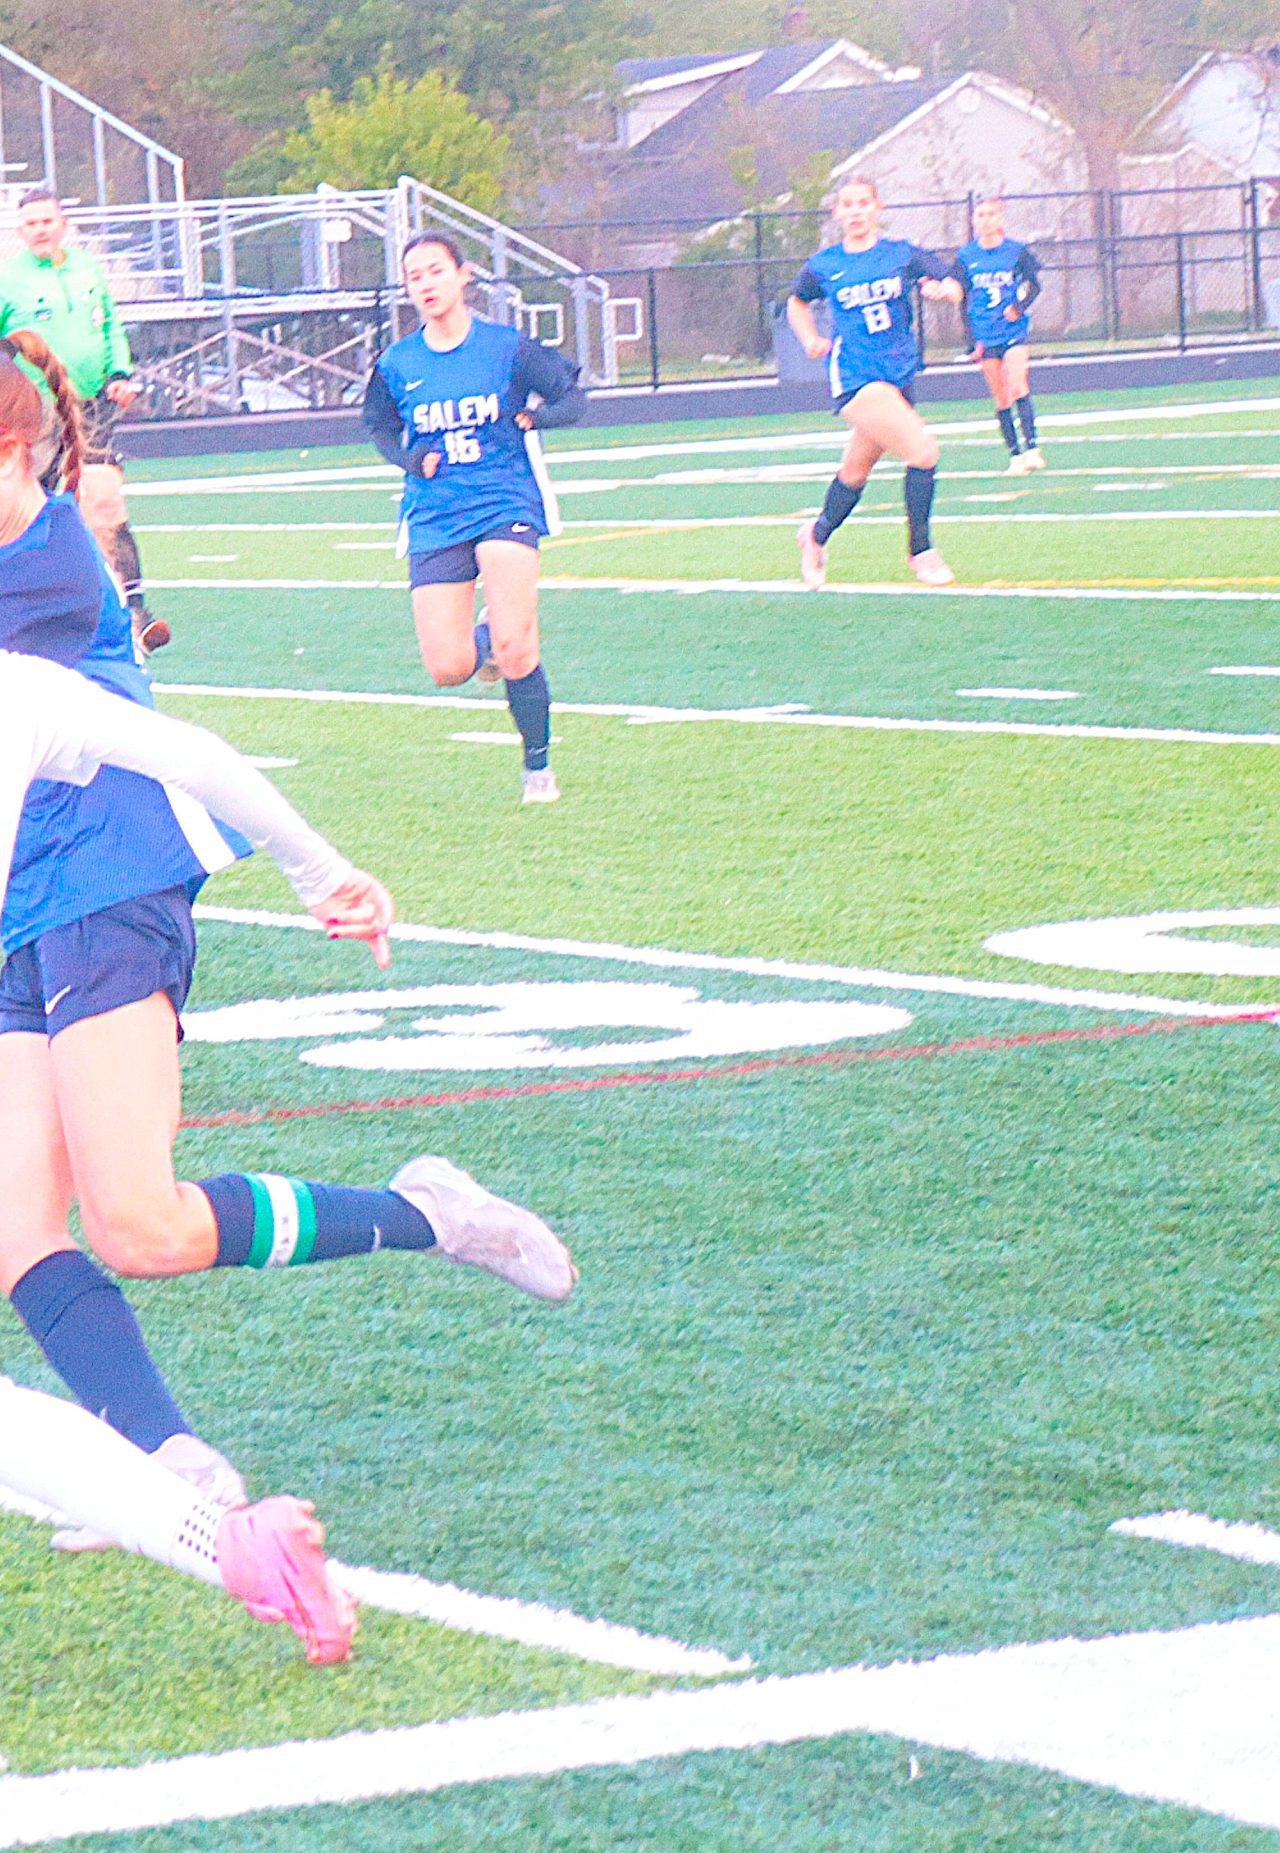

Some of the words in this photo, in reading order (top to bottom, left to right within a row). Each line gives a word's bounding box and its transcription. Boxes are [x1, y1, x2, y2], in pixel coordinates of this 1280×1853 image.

[836, 276, 903, 310] SALEM
[986, 287, 1001, 308] 3
[413, 393, 499, 433] SALEM
[444, 427, 482, 465] 16
